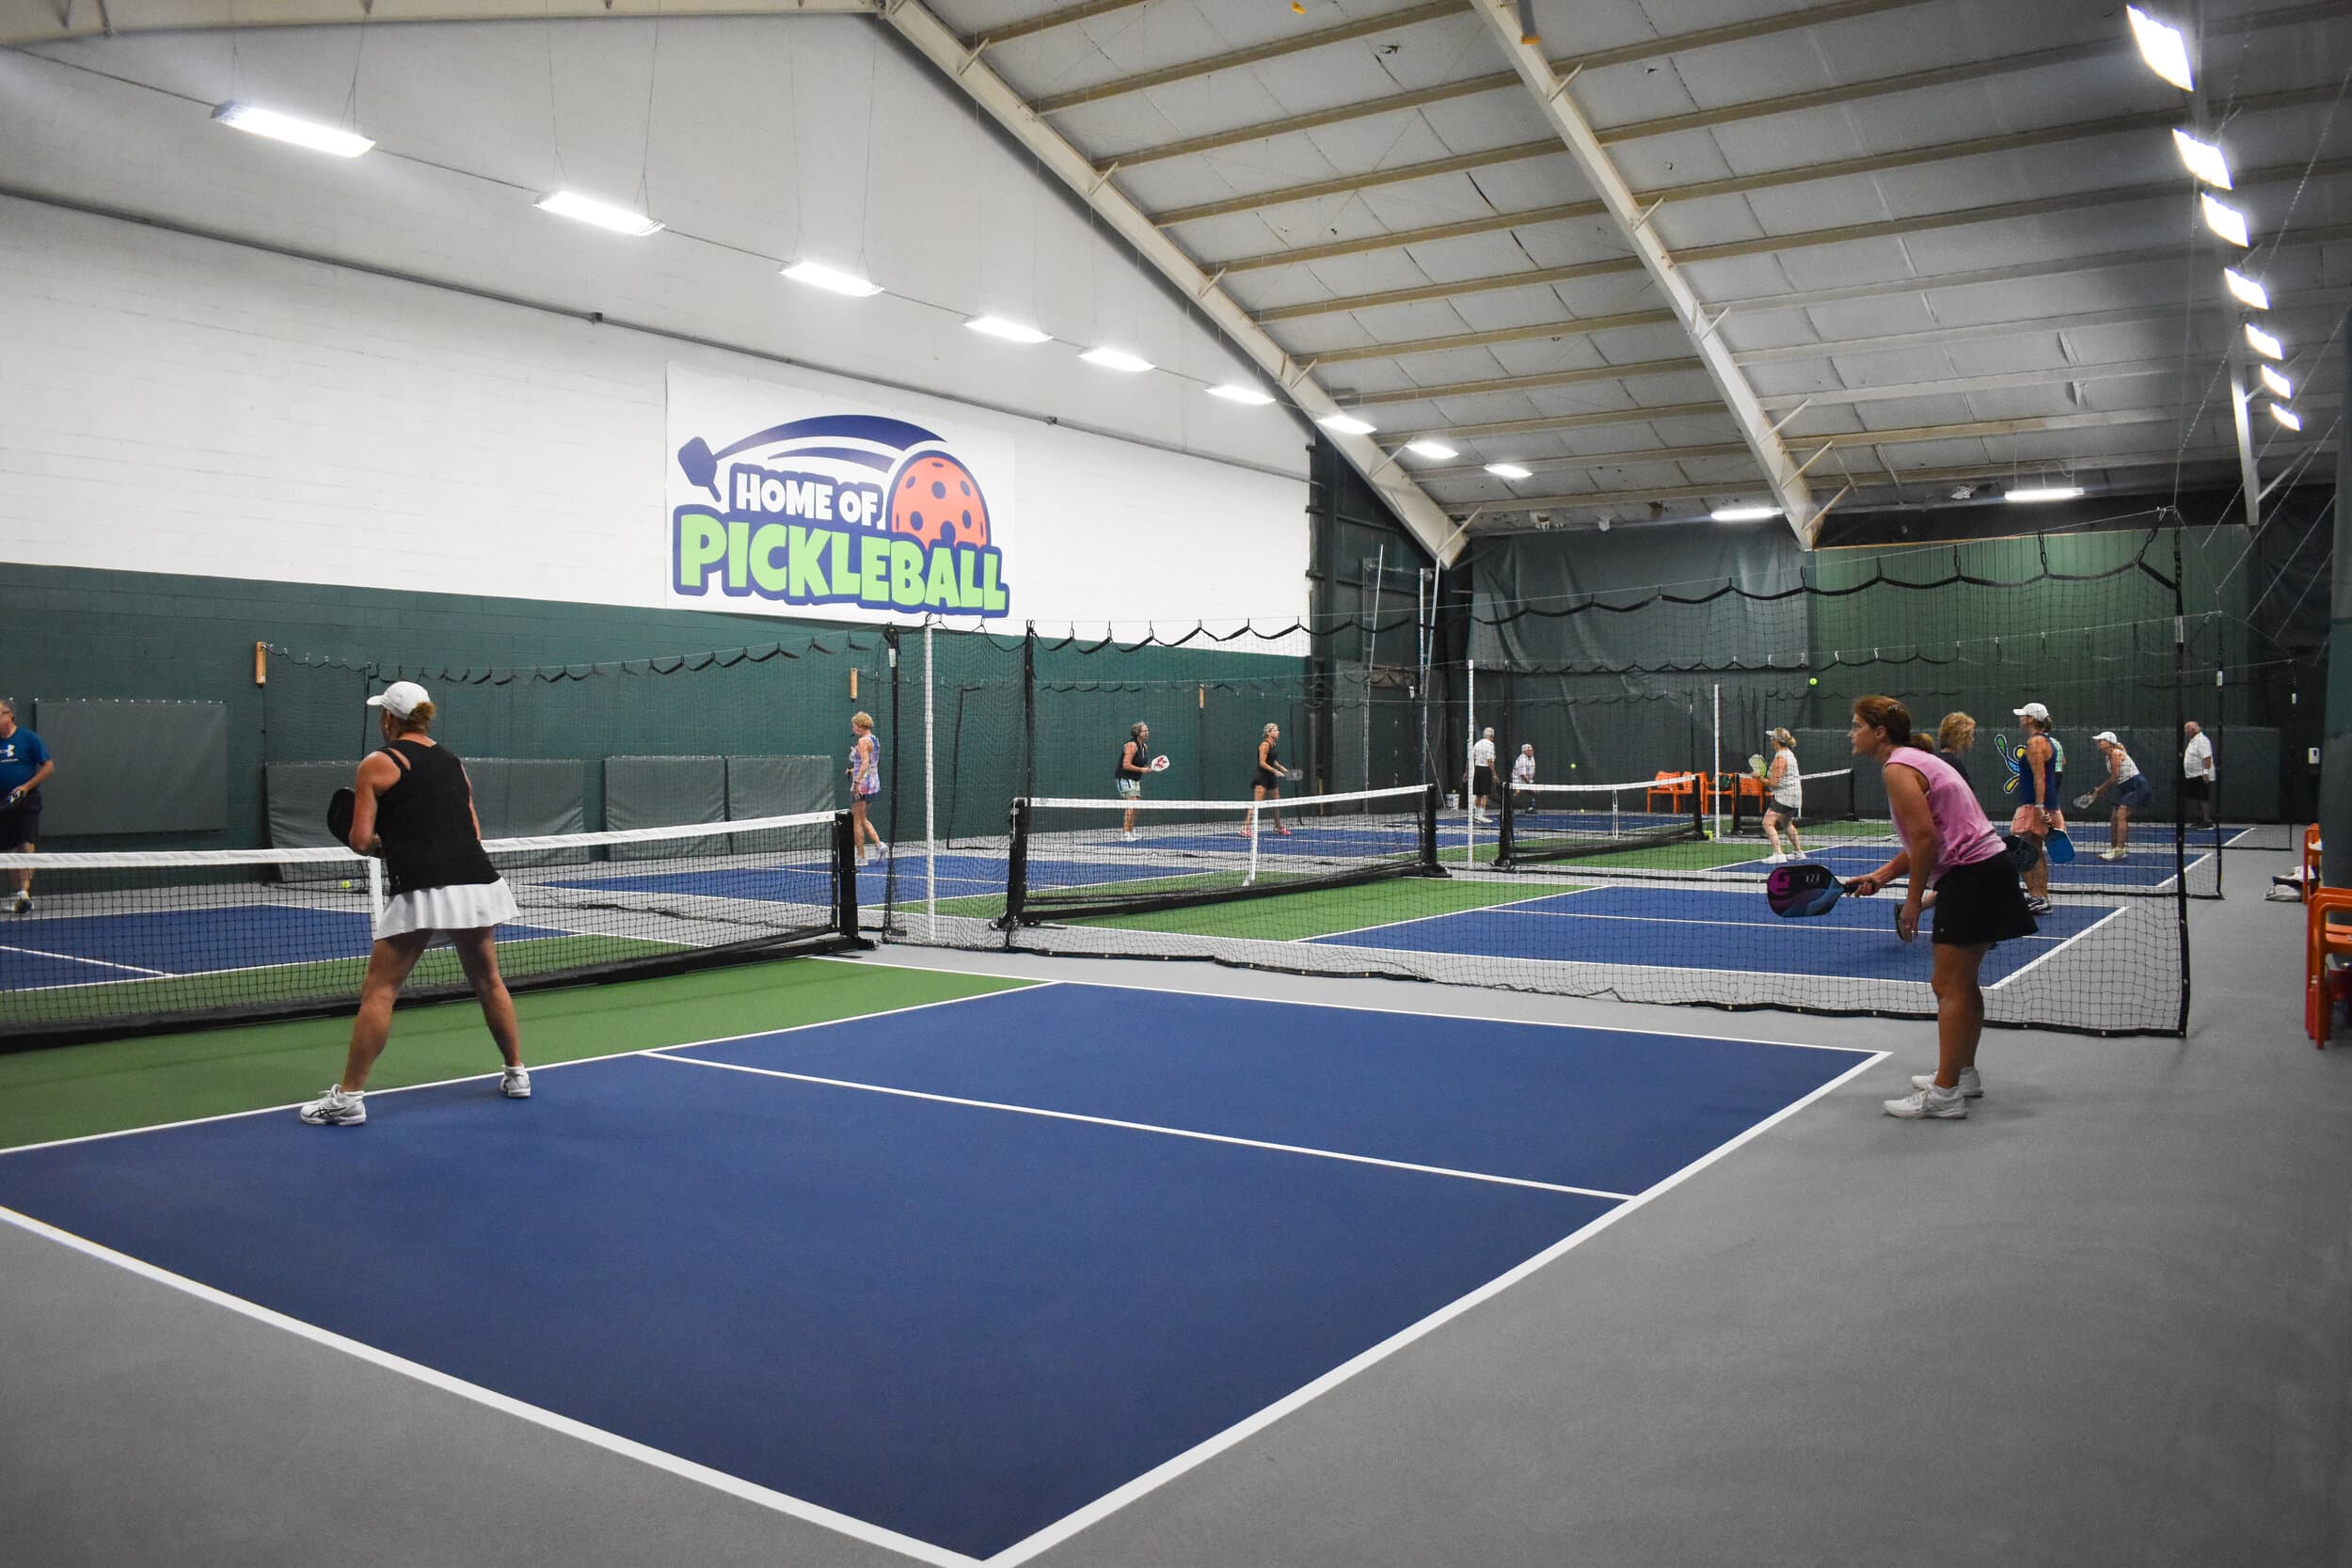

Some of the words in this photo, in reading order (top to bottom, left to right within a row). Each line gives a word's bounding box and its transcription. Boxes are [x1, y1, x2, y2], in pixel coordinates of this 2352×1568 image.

[736, 472, 833, 520] HOME
[839, 491, 878, 526] OF
[680, 514, 1006, 610] PICKLEBALL
